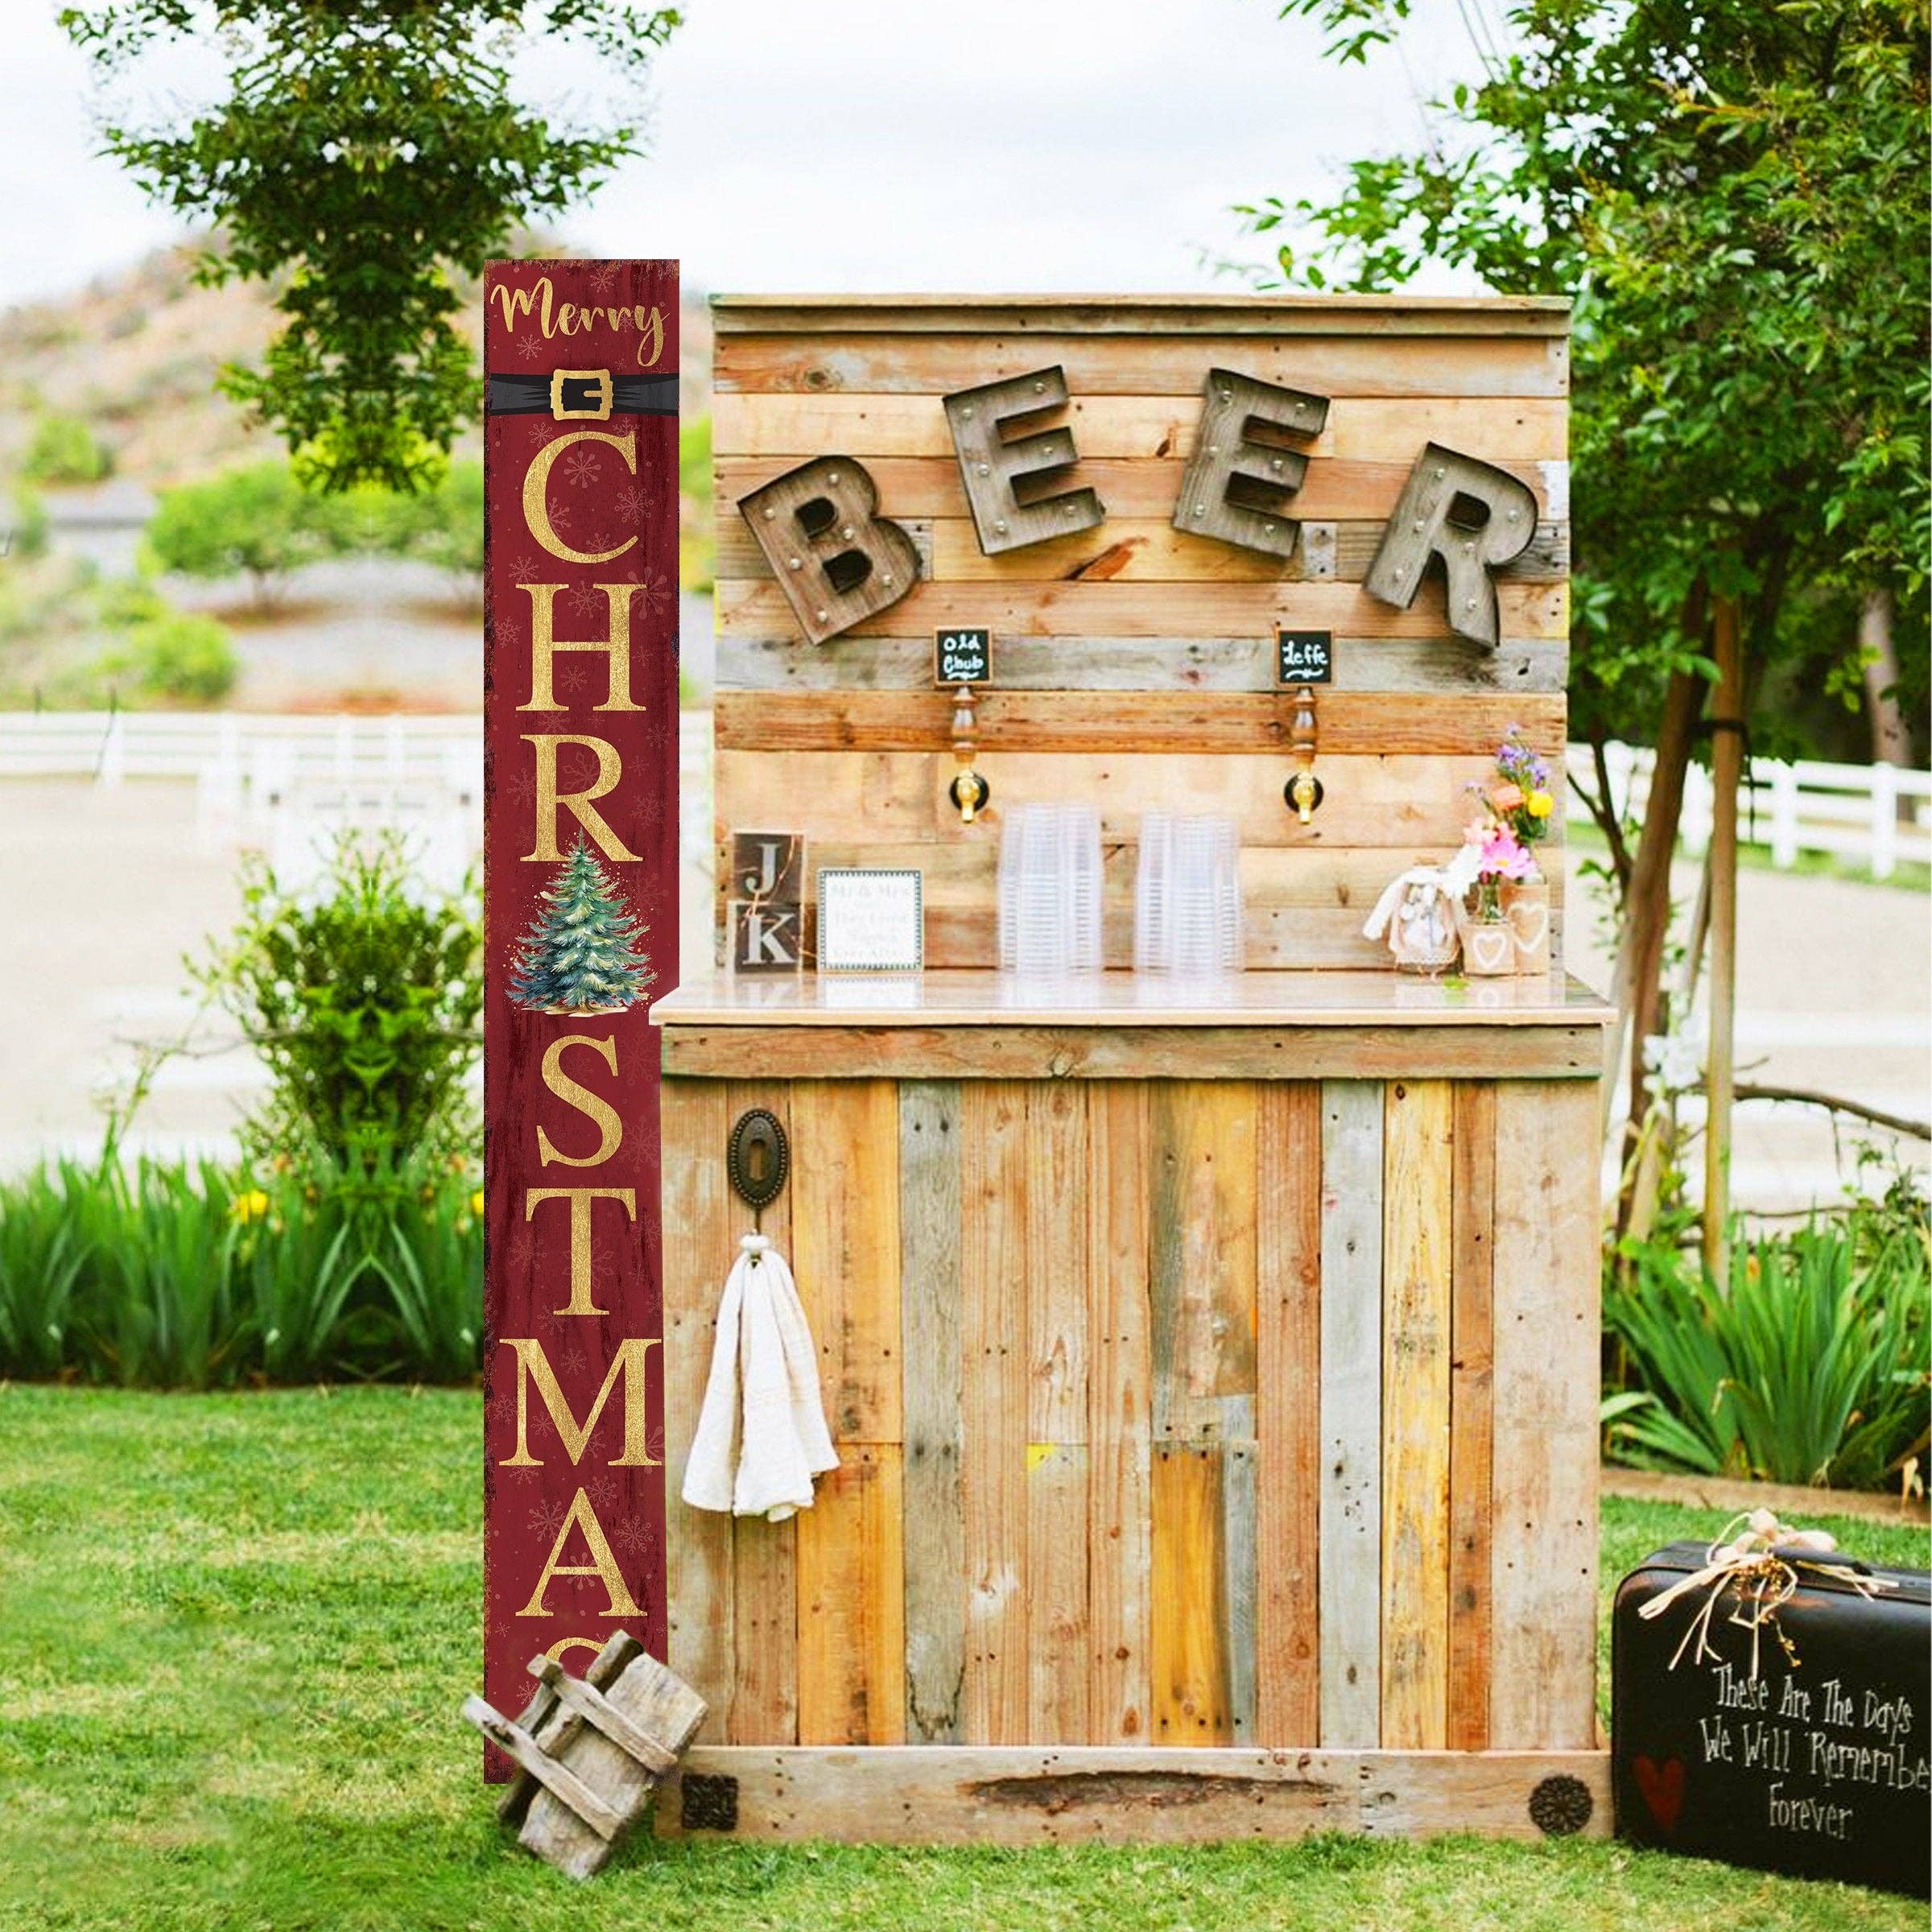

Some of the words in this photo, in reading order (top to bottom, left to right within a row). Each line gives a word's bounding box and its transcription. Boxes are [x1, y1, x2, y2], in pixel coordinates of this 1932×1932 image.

[490, 276, 671, 367] Merry
[737, 365, 1538, 648] BEER
[943, 634, 981, 652] Old
[745, 843, 782, 894] J
[741, 913, 796, 965] K
[1712, 1662, 1769, 1710] These
[1778, 1674, 1811, 1723] Are
[1821, 1678, 1854, 1727] The
[1864, 1690, 1914, 1746] Days
[1699, 1715, 1733, 1762] We
[1742, 1720, 1790, 1773] Will
[1803, 1732, 1931, 1790] Remembe
[1769, 1781, 1852, 1839] Forever
